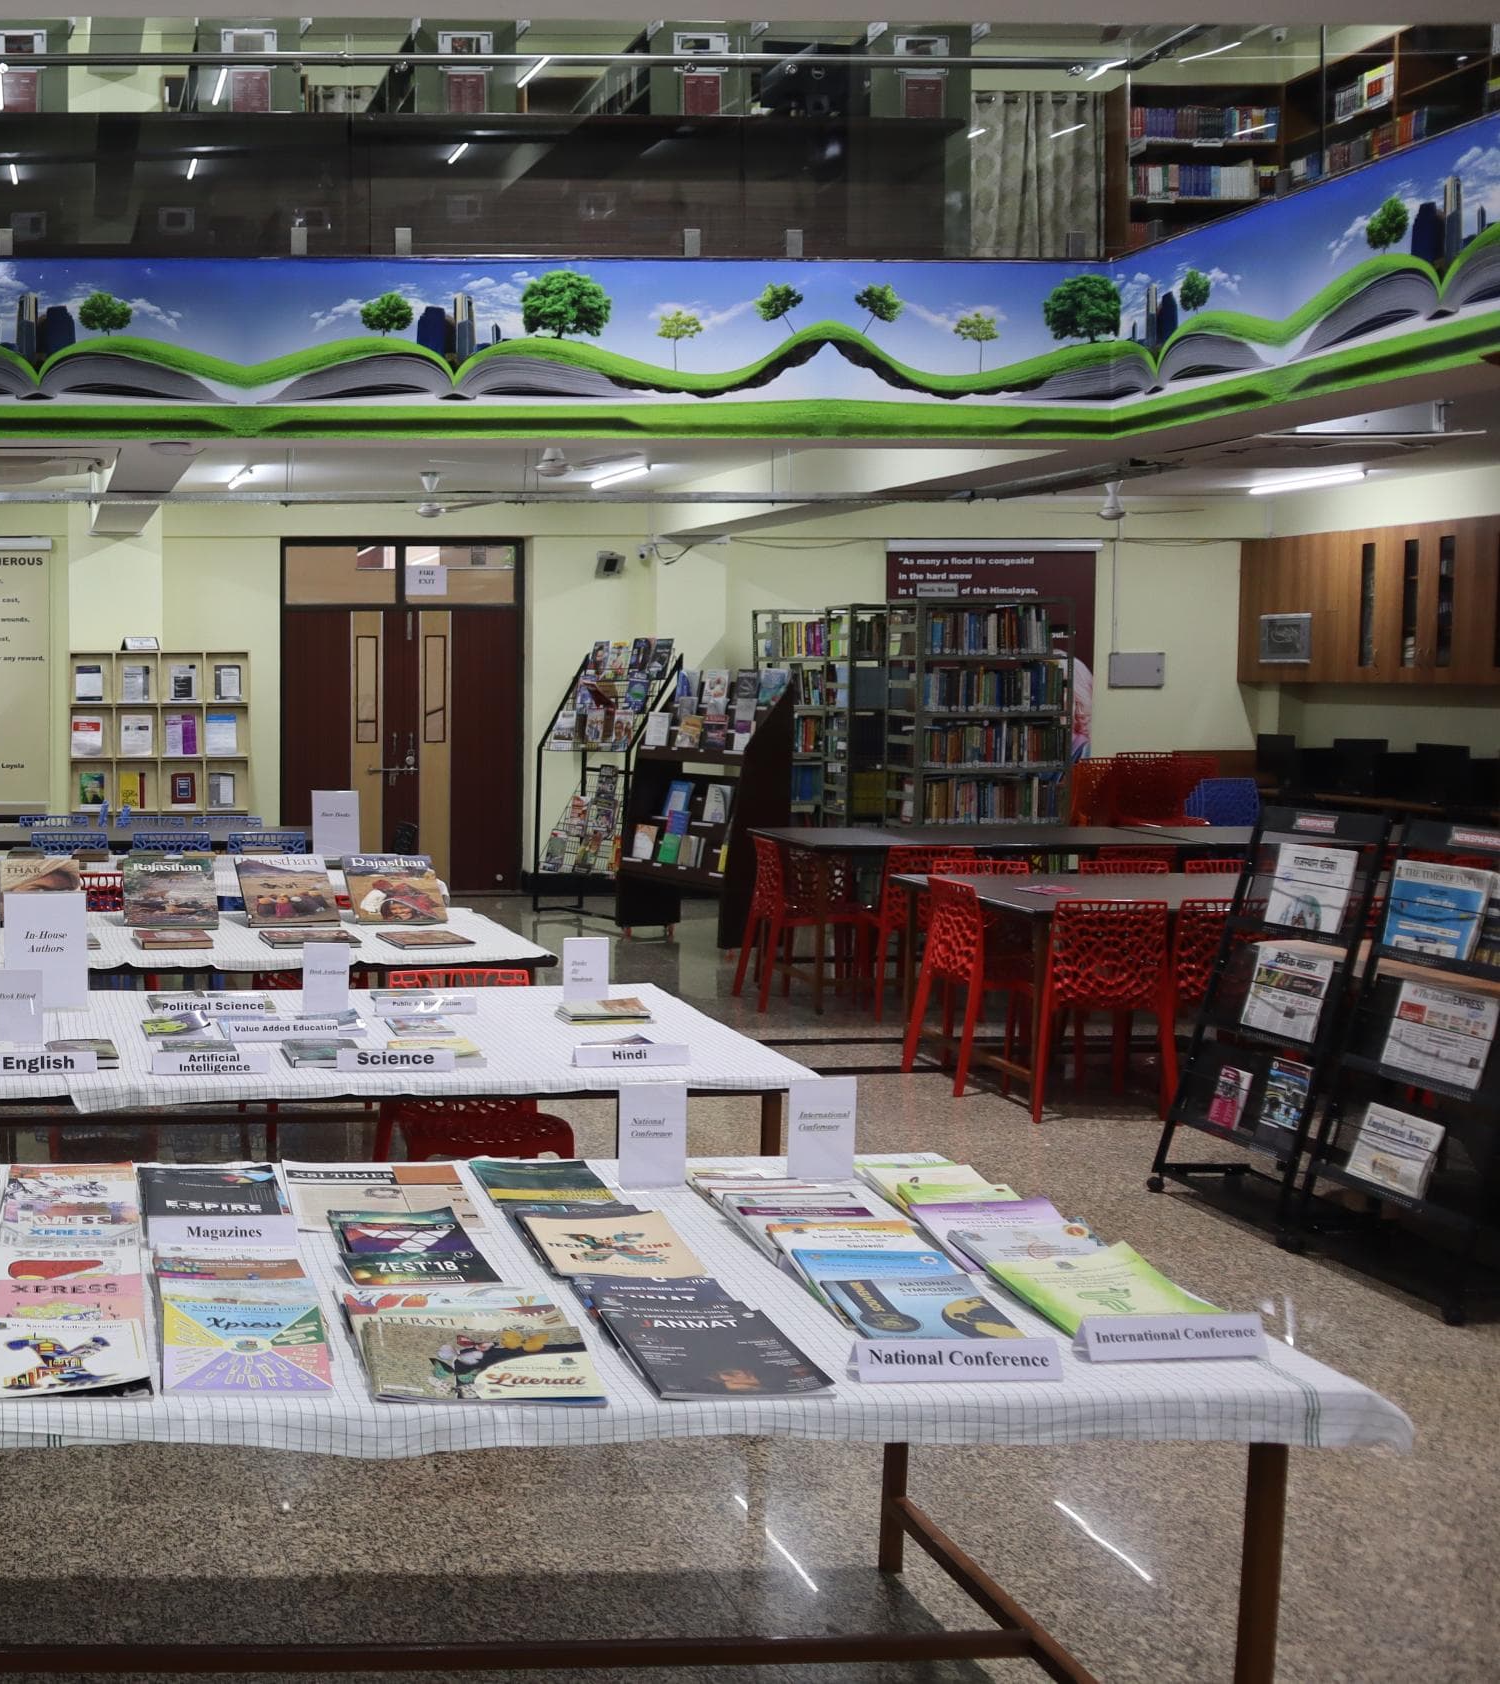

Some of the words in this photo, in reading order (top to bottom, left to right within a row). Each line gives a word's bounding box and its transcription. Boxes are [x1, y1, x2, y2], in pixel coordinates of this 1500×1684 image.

[951, 557, 973, 565] flood
[975, 557, 986, 565] lie
[989, 557, 1034, 566] congealed
[990, 587, 1038, 595] Himalayas,
[133, 863, 202, 872] Rajasthan
[351, 858, 425, 868] Rajasthan
[1405, 868, 1420, 878] THE
[25, 931, 68, 939] In-House
[28, 944, 65, 953] Authors
[162, 1002, 212, 1011] Political
[215, 1002, 264, 1011] Science
[1453, 995, 1485, 1011] EXPRESS
[293, 1024, 338, 1032] Education
[188, 1054, 240, 1063] Artificial
[357, 1053, 434, 1065] Science
[612, 1050, 647, 1060] Hindi
[3, 1056, 74, 1073] English
[179, 1063, 250, 1073] Intelligence
[799, 1111, 850, 1119] International
[631, 1118, 665, 1126] National
[798, 1123, 840, 1131] Conference
[165, 1200, 262, 1212] E-SPIRE
[29, 1228, 102, 1236] XPRESS
[186, 1226, 262, 1241] Magazines
[376, 1260, 459, 1273] ZEST'18
[11, 1283, 119, 1294] XPRESS
[206, 1317, 284, 1330] Xpress
[641, 1319, 738, 1329] JANMAT
[1095, 1331, 1181, 1344] International
[1184, 1328, 1257, 1340] Conference
[869, 1349, 943, 1366] National
[949, 1351, 1049, 1368] Conference
[485, 1373, 587, 1386] Literati
